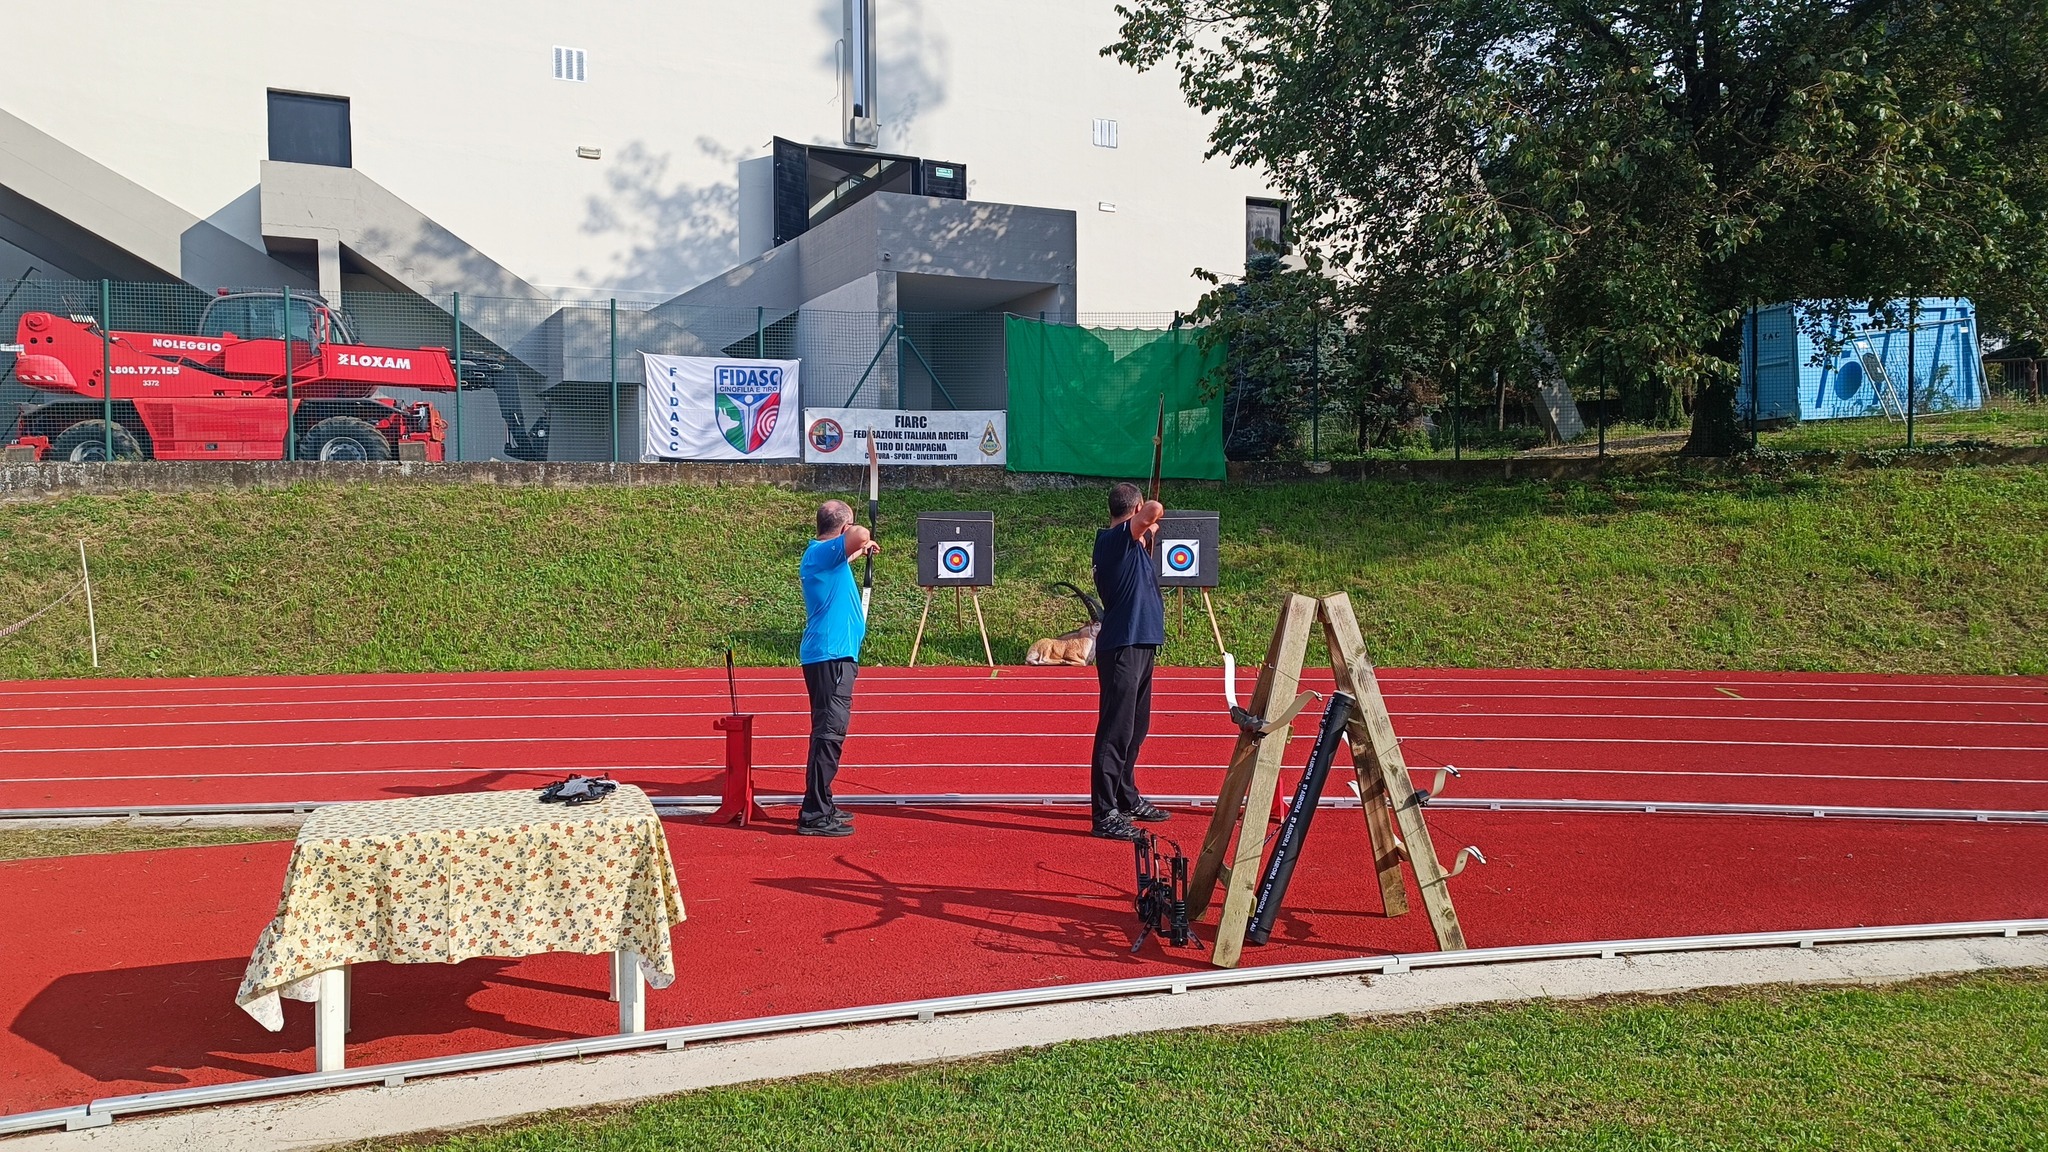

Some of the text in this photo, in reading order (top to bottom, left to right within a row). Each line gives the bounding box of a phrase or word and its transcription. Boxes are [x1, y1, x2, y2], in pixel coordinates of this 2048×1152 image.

[152, 338, 222, 351] NOLEGGIO
[350, 354, 411, 370] LOXAM
[719, 369, 779, 386] FIDASC
[895, 415, 927, 428] FIARC
[854, 430, 968, 440] FEDRAZIONE ITALIANA ARCIERI
[876, 442, 946, 452] TIRO DI CAMPAGNA
[917, 453, 957, 461] DIVERTIMENTO
[1305, 756, 1317, 780] AURORA
[1293, 791, 1307, 813] AURORA
[1281, 822, 1296, 847] AURORA
[1269, 857, 1283, 880] AURORA
[1256, 889, 1270, 913] AURORA
